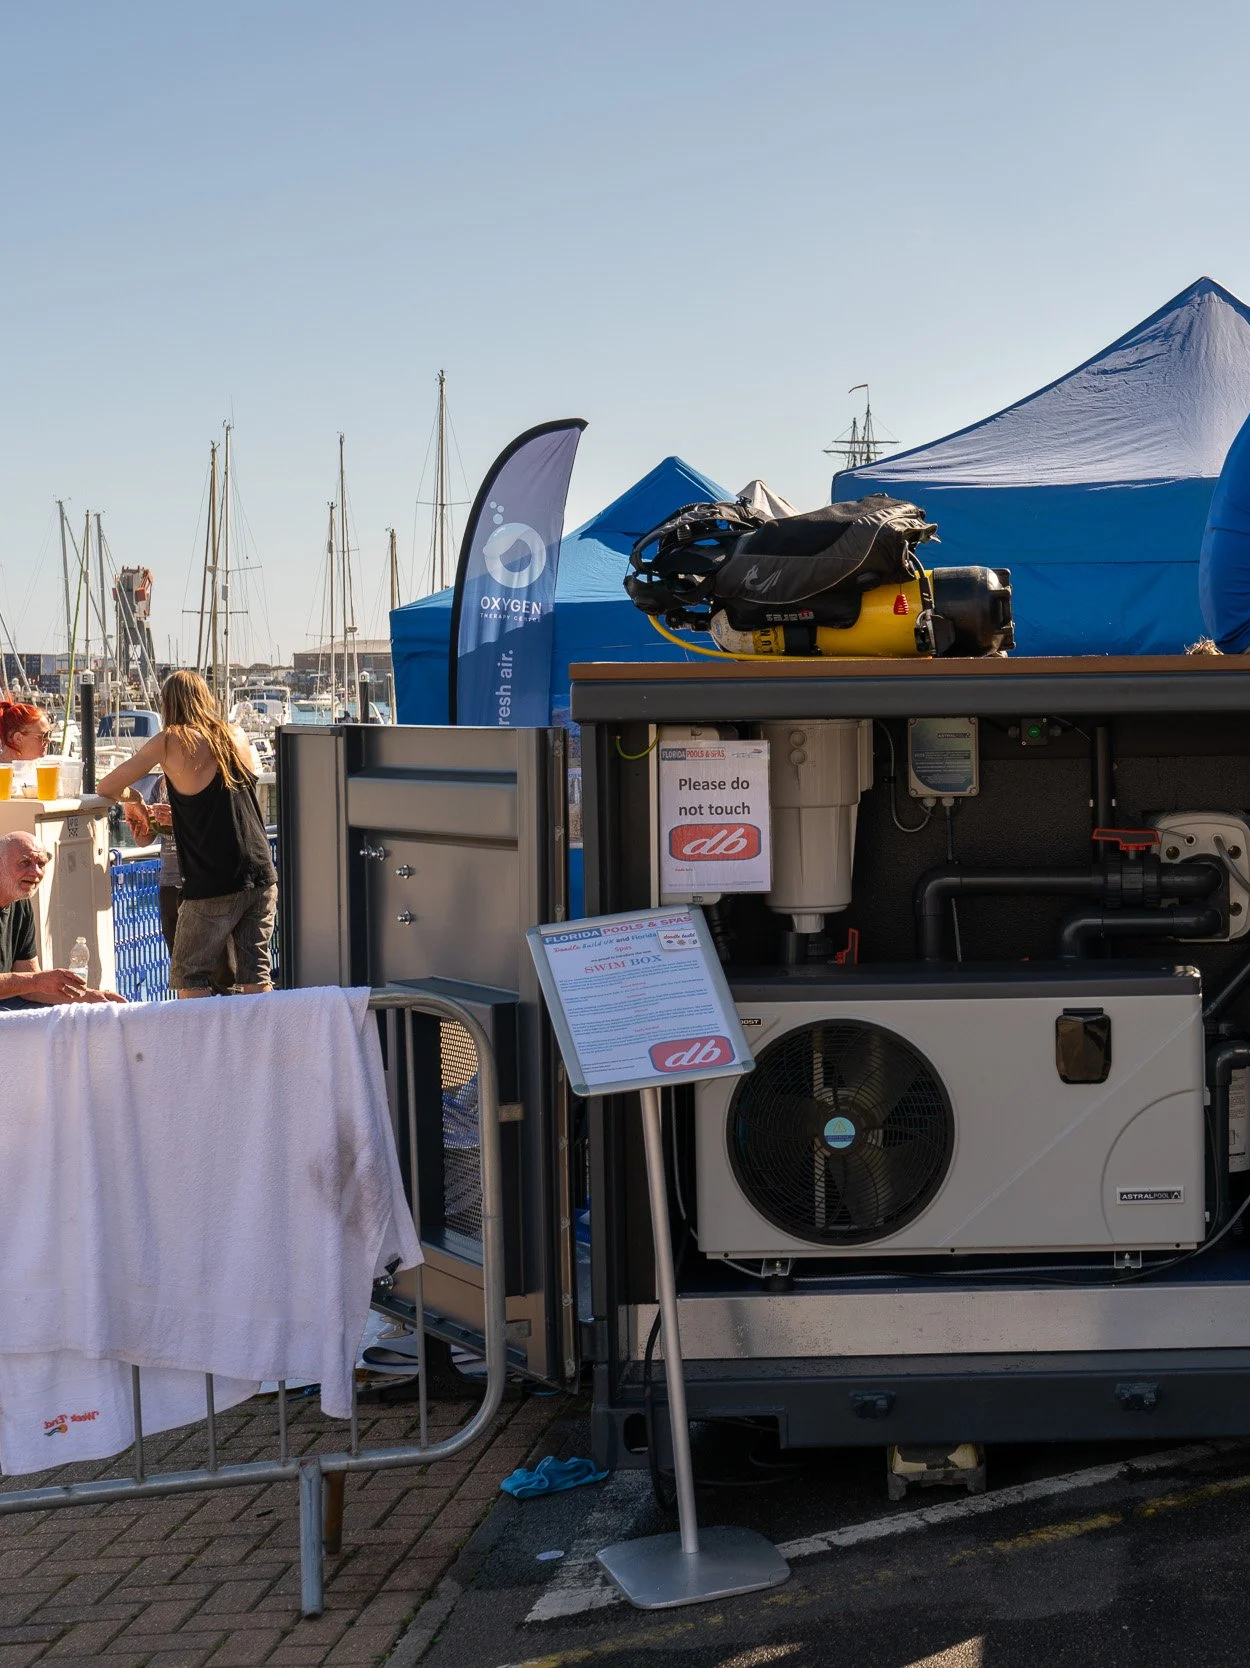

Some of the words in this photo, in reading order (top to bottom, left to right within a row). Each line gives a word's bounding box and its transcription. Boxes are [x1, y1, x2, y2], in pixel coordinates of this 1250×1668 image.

[480, 596, 542, 614] OXYGEN
[480, 612, 511, 620] THERAPY
[497, 649, 514, 679] air.
[661, 749, 686, 760] FLORIDA
[687, 749, 704, 759] POOLS
[710, 749, 725, 759] SPAS
[678, 777, 727, 791] Please
[731, 777, 750, 790] do
[678, 803, 704, 816] not
[708, 802, 751, 816] touch
[682, 827, 749, 855] db
[544, 929, 600, 944] FLORIDA
[603, 922, 644, 935] POOLS
[661, 915, 693, 926] SPAS
[631, 932, 657, 941] Florida
[584, 960, 626, 975] SWIM
[629, 954, 663, 967] BOX
[664, 1039, 722, 1067] db
[1121, 1192, 1170, 1200] ASTRALPOOL
